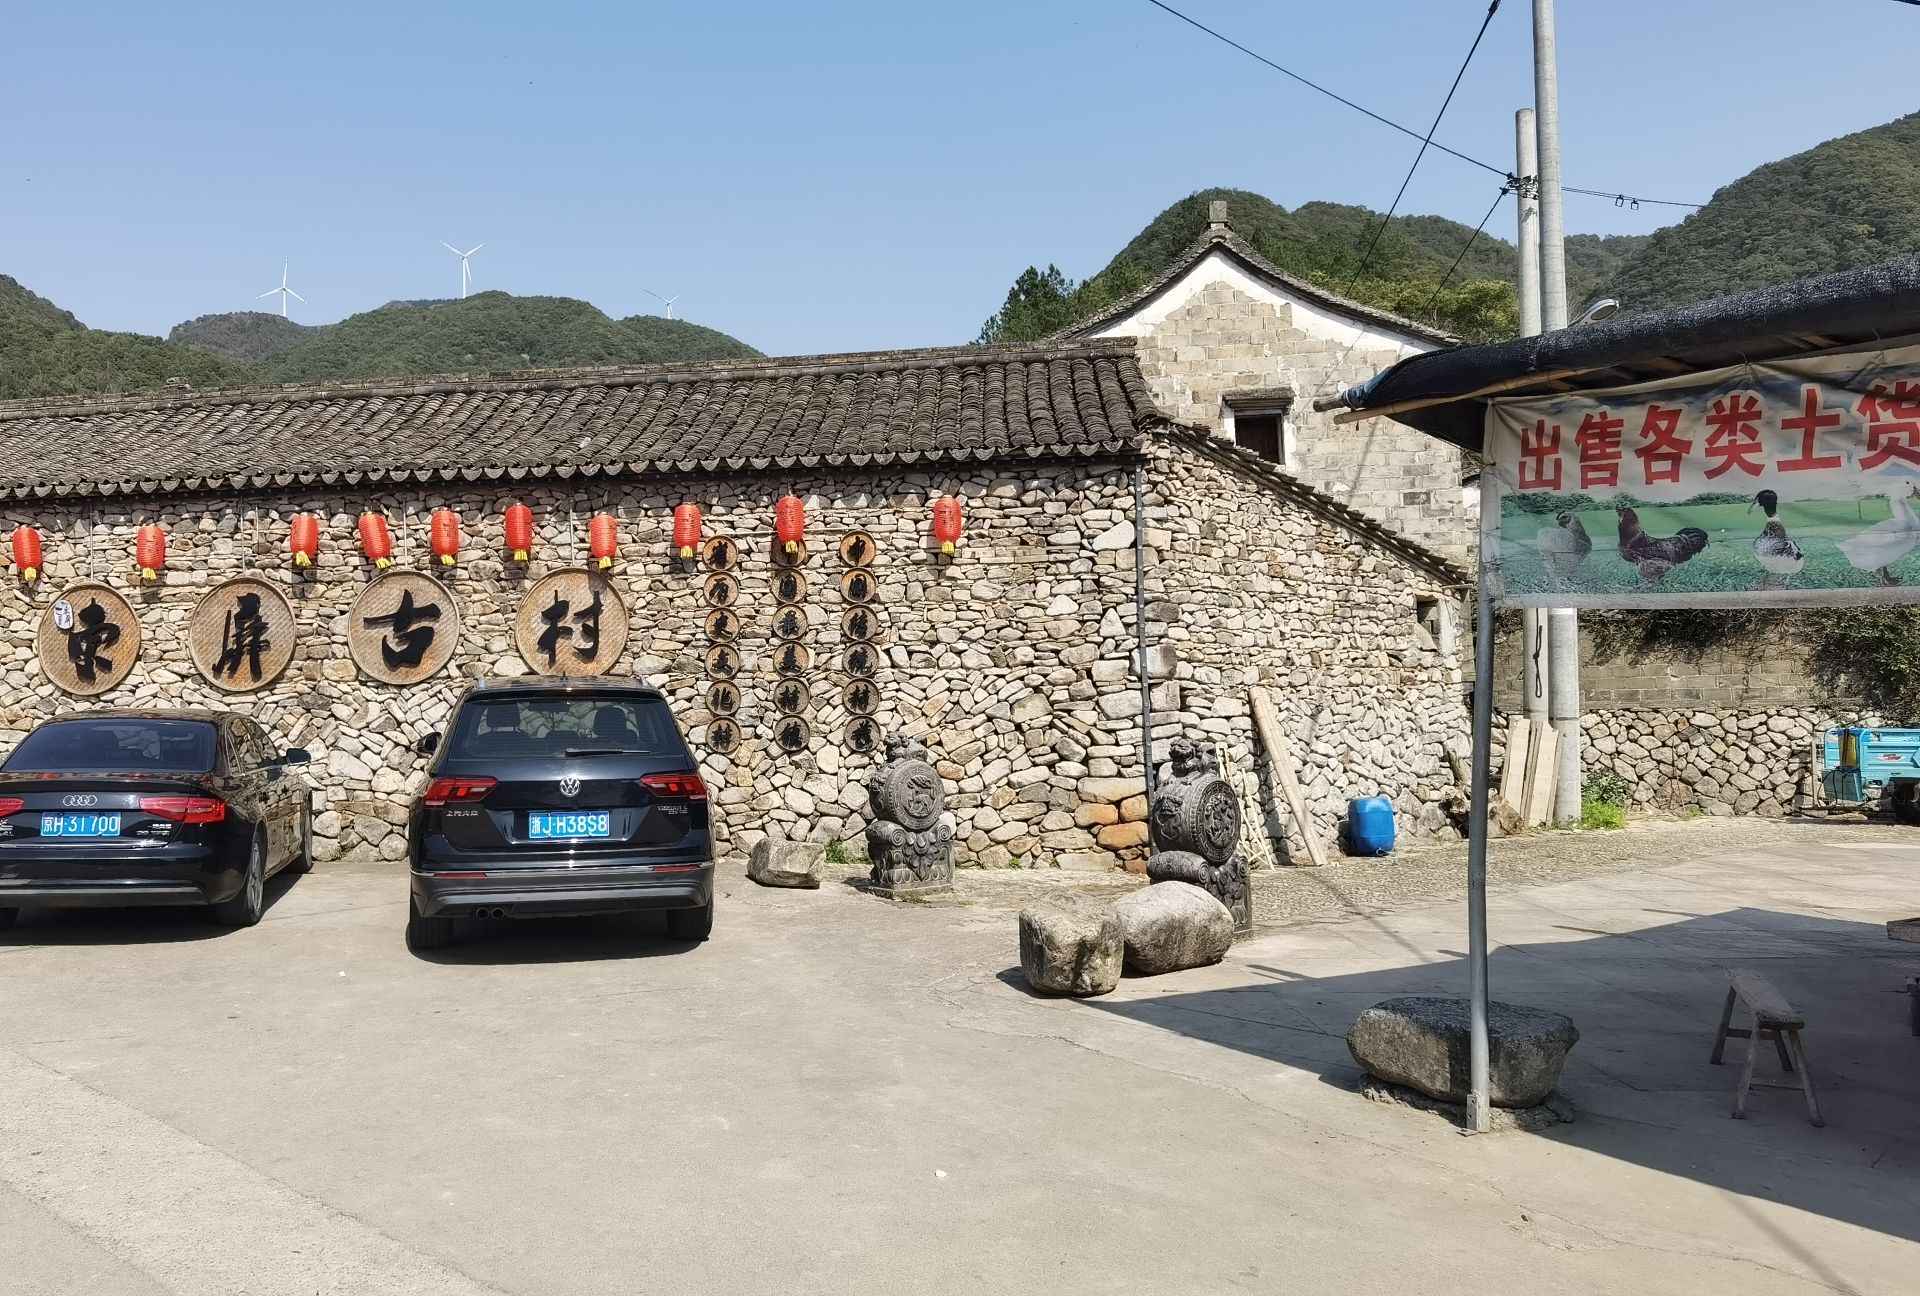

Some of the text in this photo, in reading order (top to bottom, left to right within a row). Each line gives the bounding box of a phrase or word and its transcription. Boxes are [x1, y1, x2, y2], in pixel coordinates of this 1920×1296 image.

[1518, 381, 1920, 491] 出售各类土货
